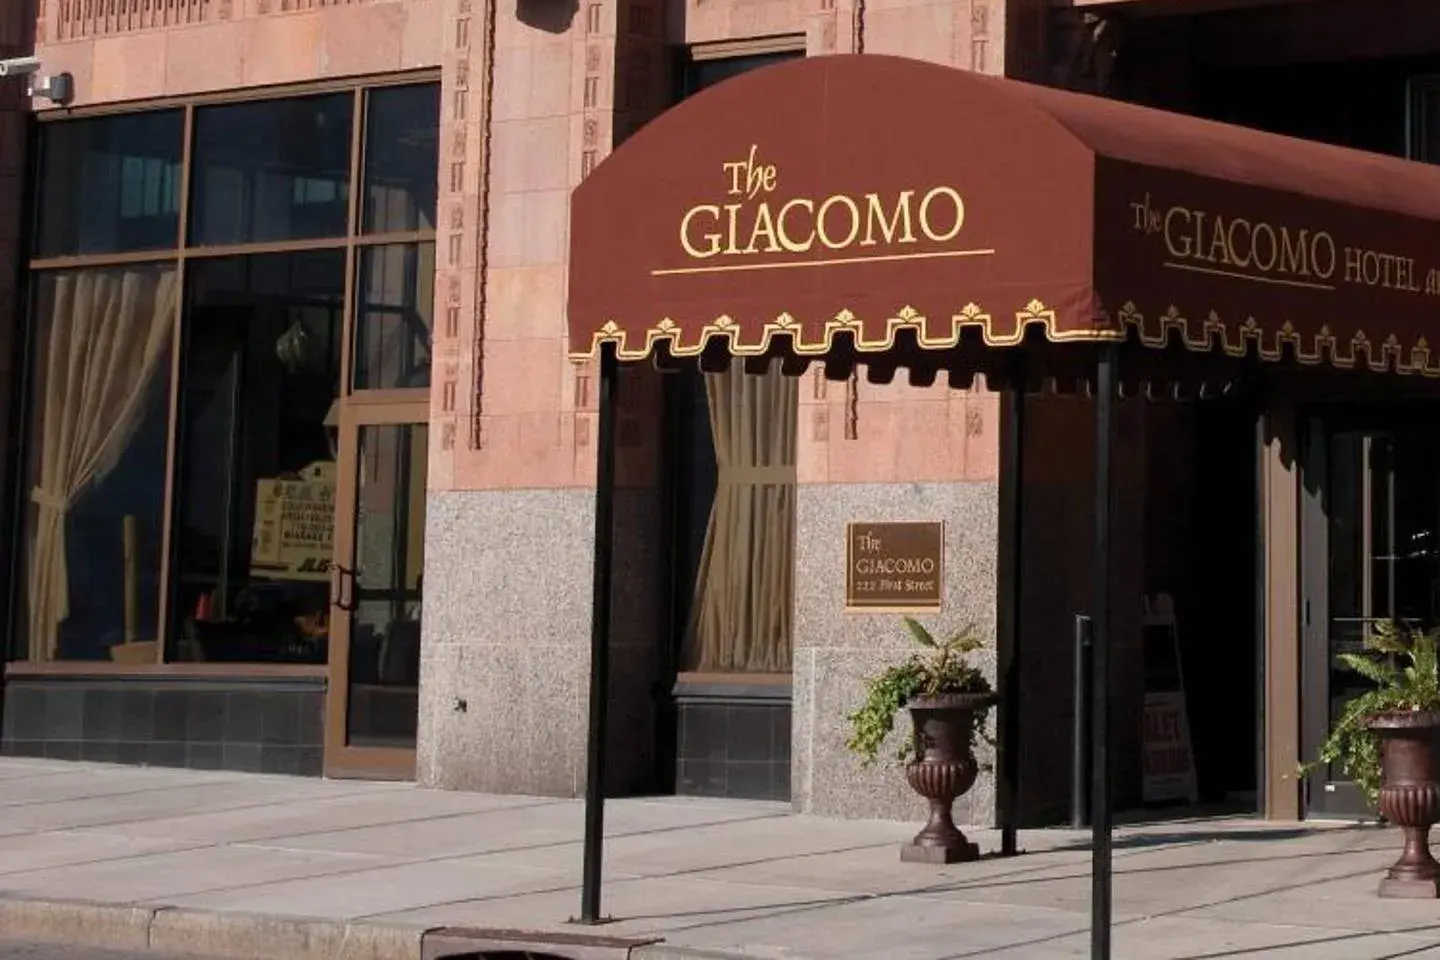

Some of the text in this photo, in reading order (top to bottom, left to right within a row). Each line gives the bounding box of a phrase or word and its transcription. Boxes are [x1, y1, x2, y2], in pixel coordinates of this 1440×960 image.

[723, 143, 777, 201] The
[680, 186, 965, 258] GIACOMO
[1129, 192, 1163, 234] The
[1163, 205, 1336, 279] GIACOMO
[1345, 246, 1420, 292] HOTEL
[855, 558, 934, 574] GIACOMO
[857, 530, 881, 552] The
